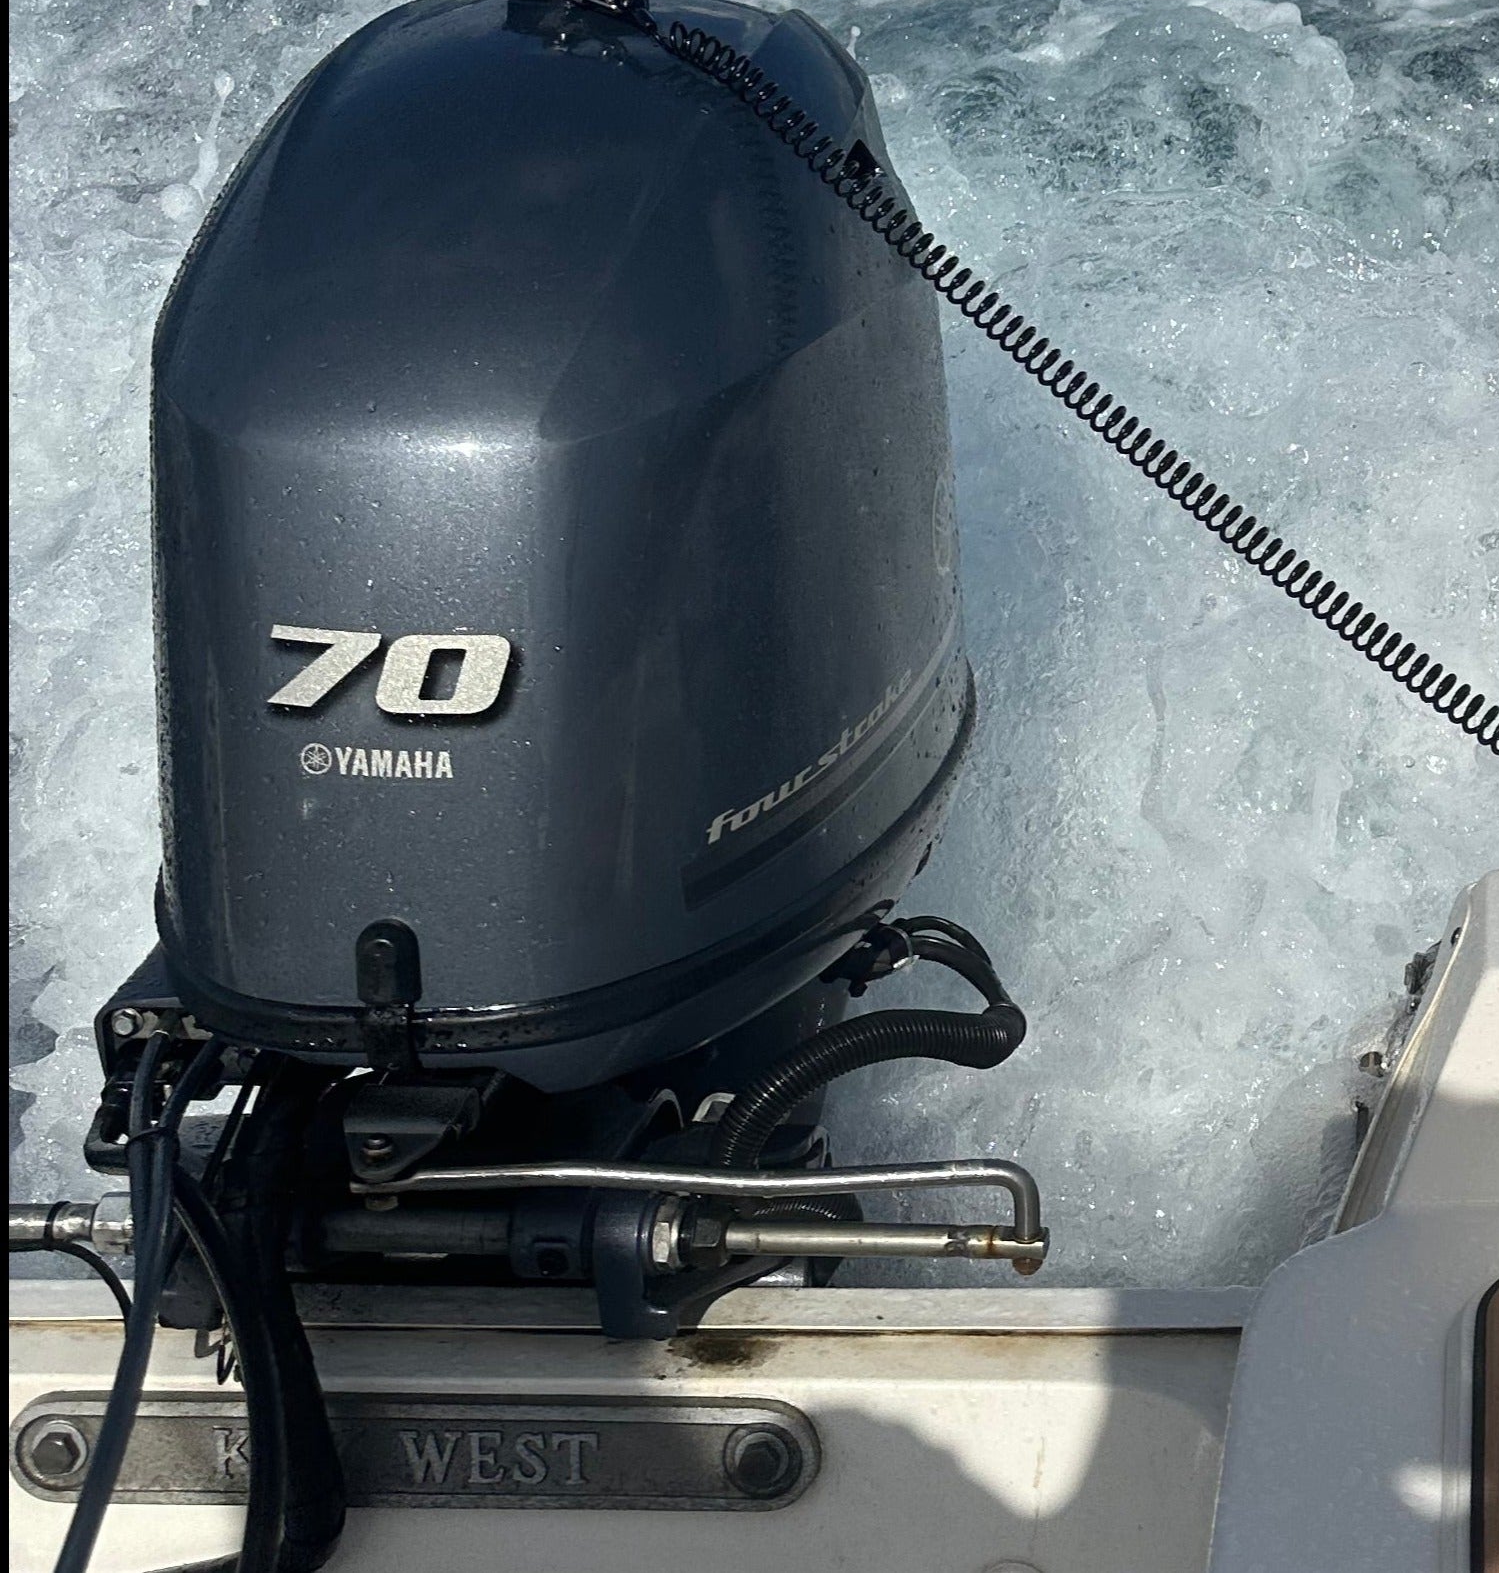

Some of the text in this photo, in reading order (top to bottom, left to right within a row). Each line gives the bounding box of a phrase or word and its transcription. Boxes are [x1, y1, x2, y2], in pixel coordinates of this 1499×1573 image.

[267, 624, 511, 715] 70
[334, 747, 453, 778] YAMAHA
[400, 1429, 599, 1485] WEST
